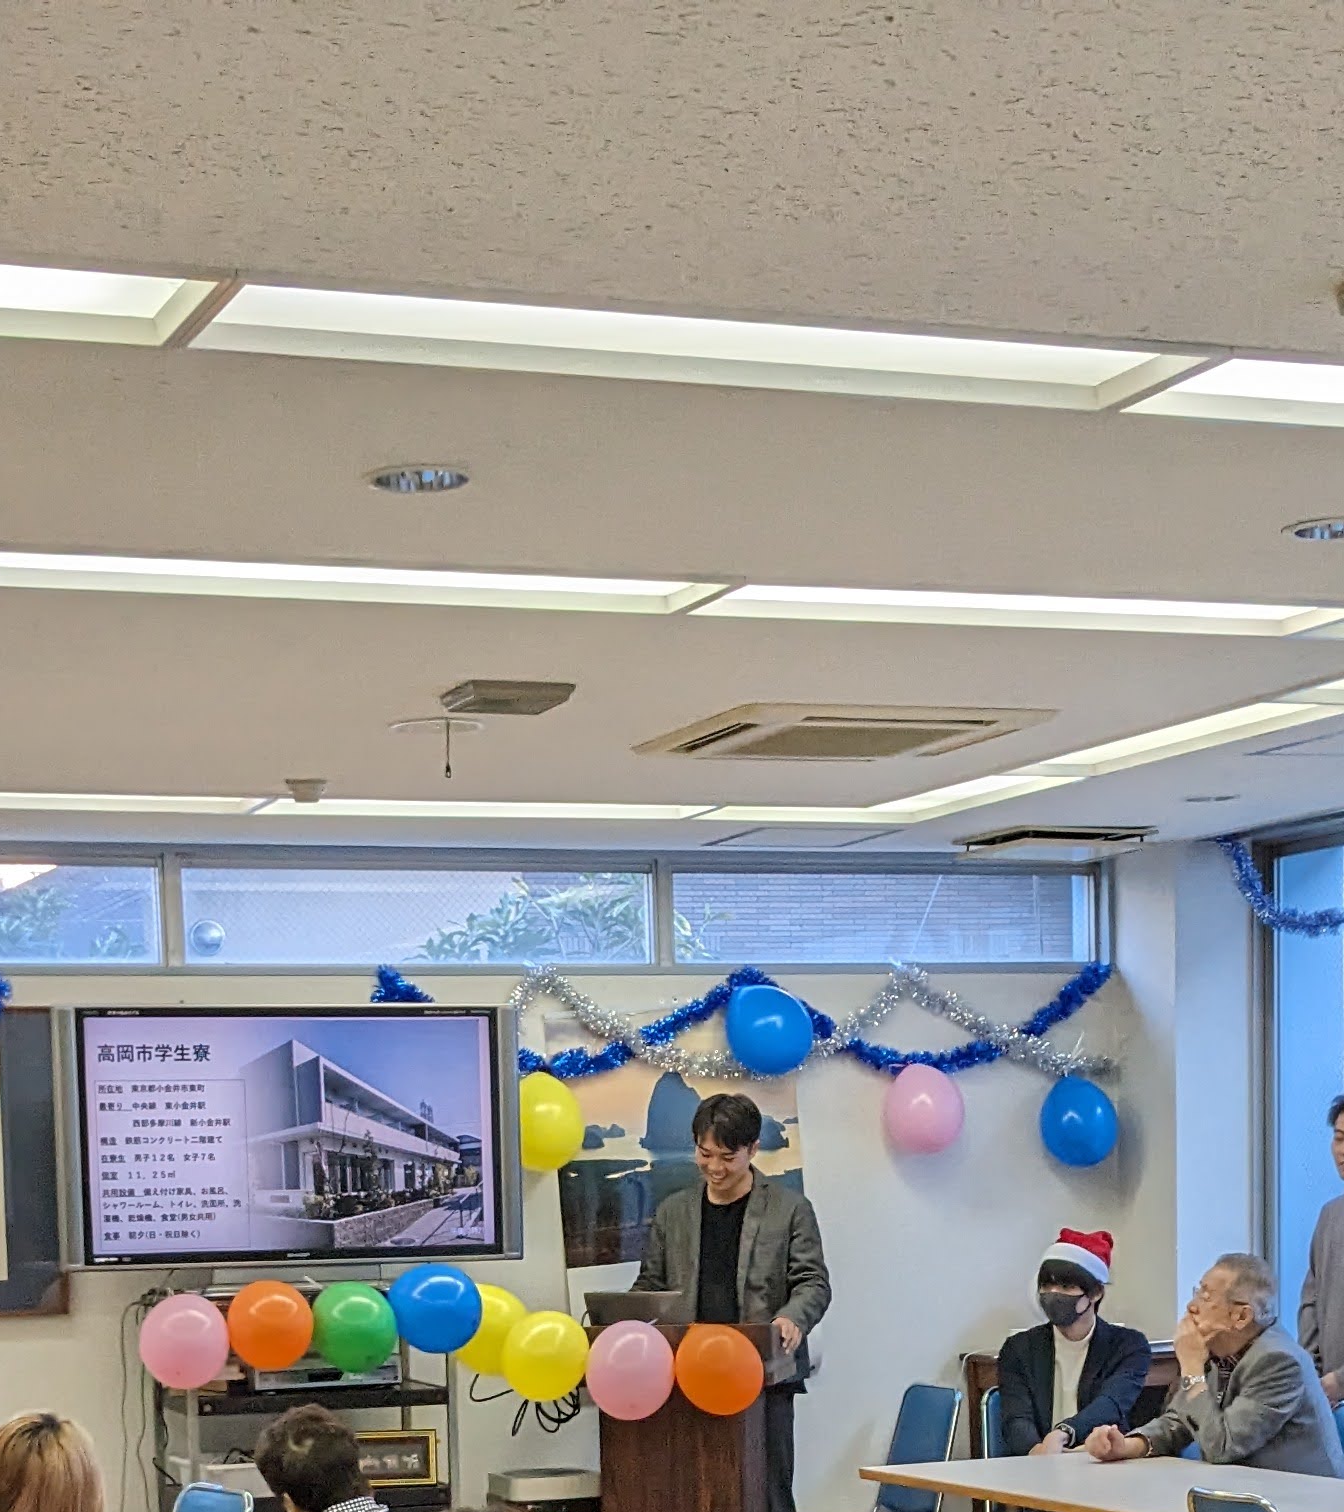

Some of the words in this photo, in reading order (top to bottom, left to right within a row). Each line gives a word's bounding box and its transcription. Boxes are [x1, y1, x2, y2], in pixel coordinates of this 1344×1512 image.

[97, 1044, 211, 1063] 高岡市学生寮
[98, 1085, 123, 1093] 所在地
[132, 1102, 156, 1110] 中央線
[165, 1101, 206, 1110] 東小金井駅
